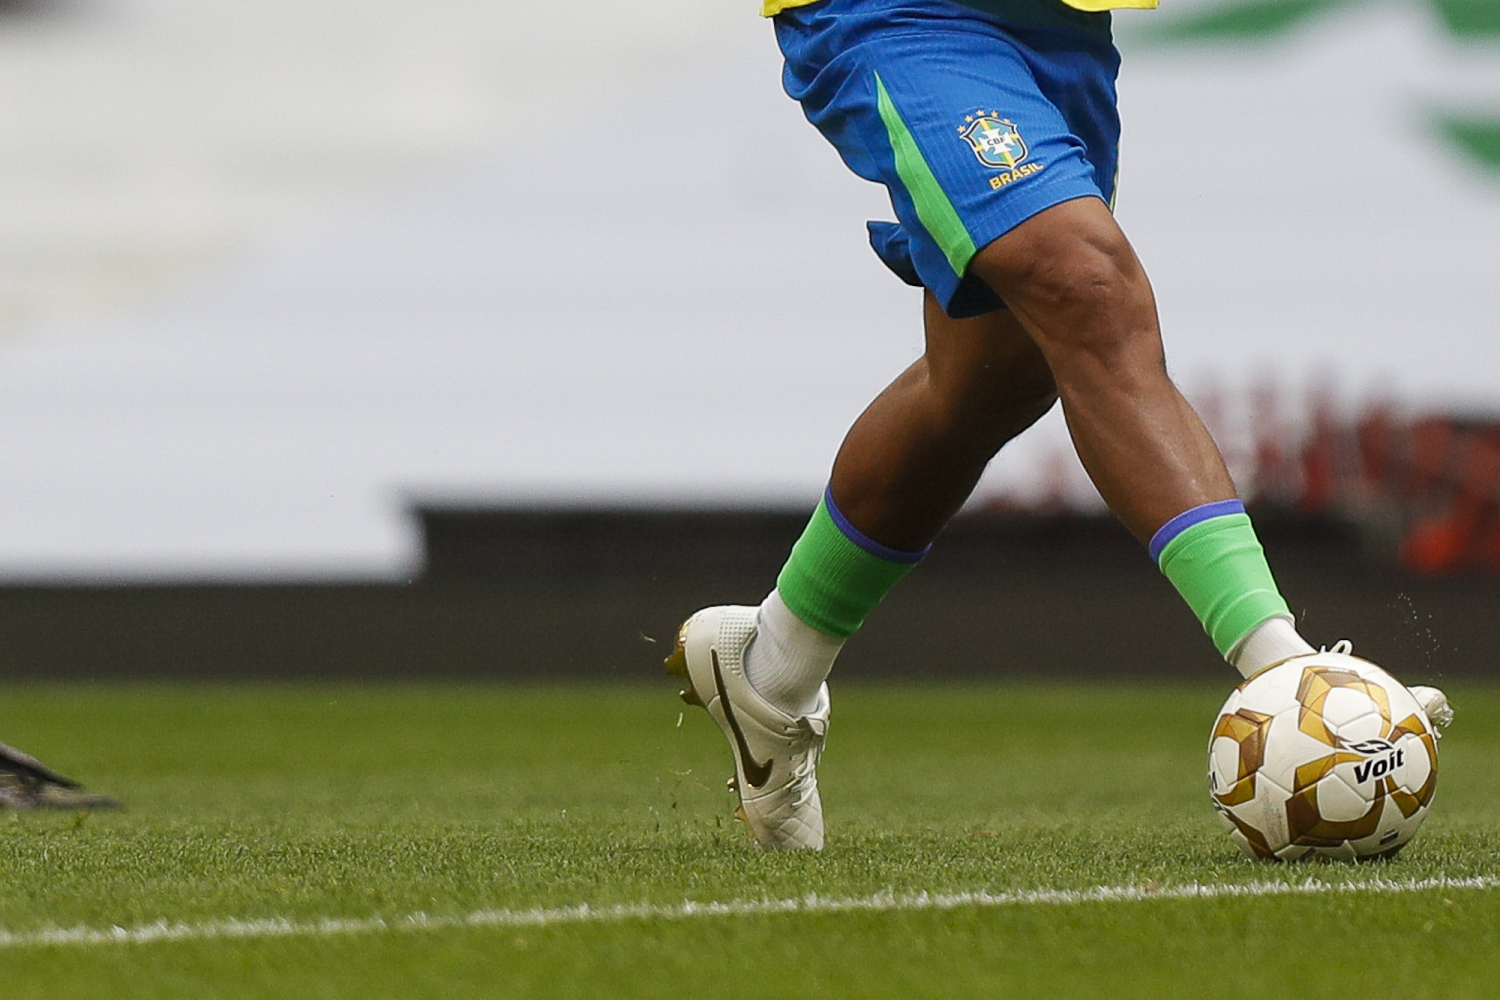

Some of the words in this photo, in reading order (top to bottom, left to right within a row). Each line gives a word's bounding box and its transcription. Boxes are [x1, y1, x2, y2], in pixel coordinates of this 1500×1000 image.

[987, 137, 1006, 146] CBF
[988, 162, 1045, 190] BRASIL
[1353, 748, 1404, 785] Voit
